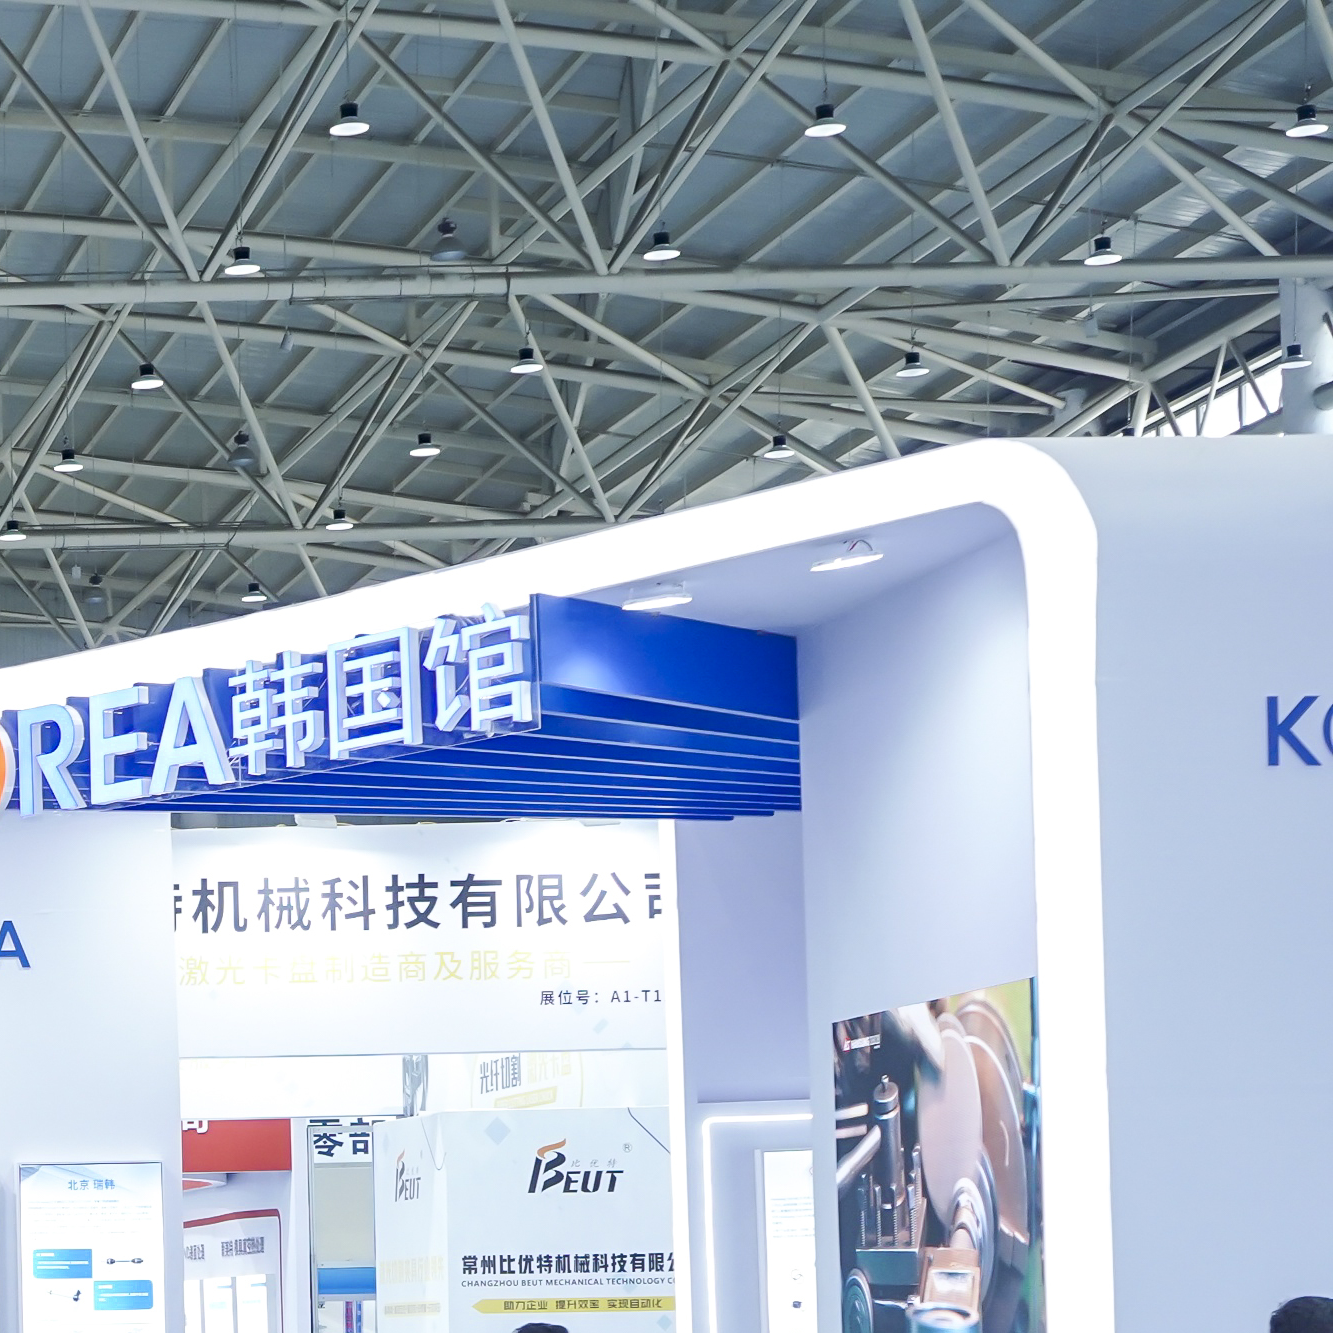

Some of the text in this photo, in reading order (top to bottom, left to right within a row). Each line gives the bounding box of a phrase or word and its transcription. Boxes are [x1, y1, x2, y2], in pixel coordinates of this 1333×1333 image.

[1266, 695, 1333, 767] K
[461, 1279, 519, 1288] CHANGZHOU
[521, 1279, 543, 1287] BEUT
[545, 1278, 604, 1286] MECHANICAL
[606, 1277, 666, 1285] TECHNOLOGY
